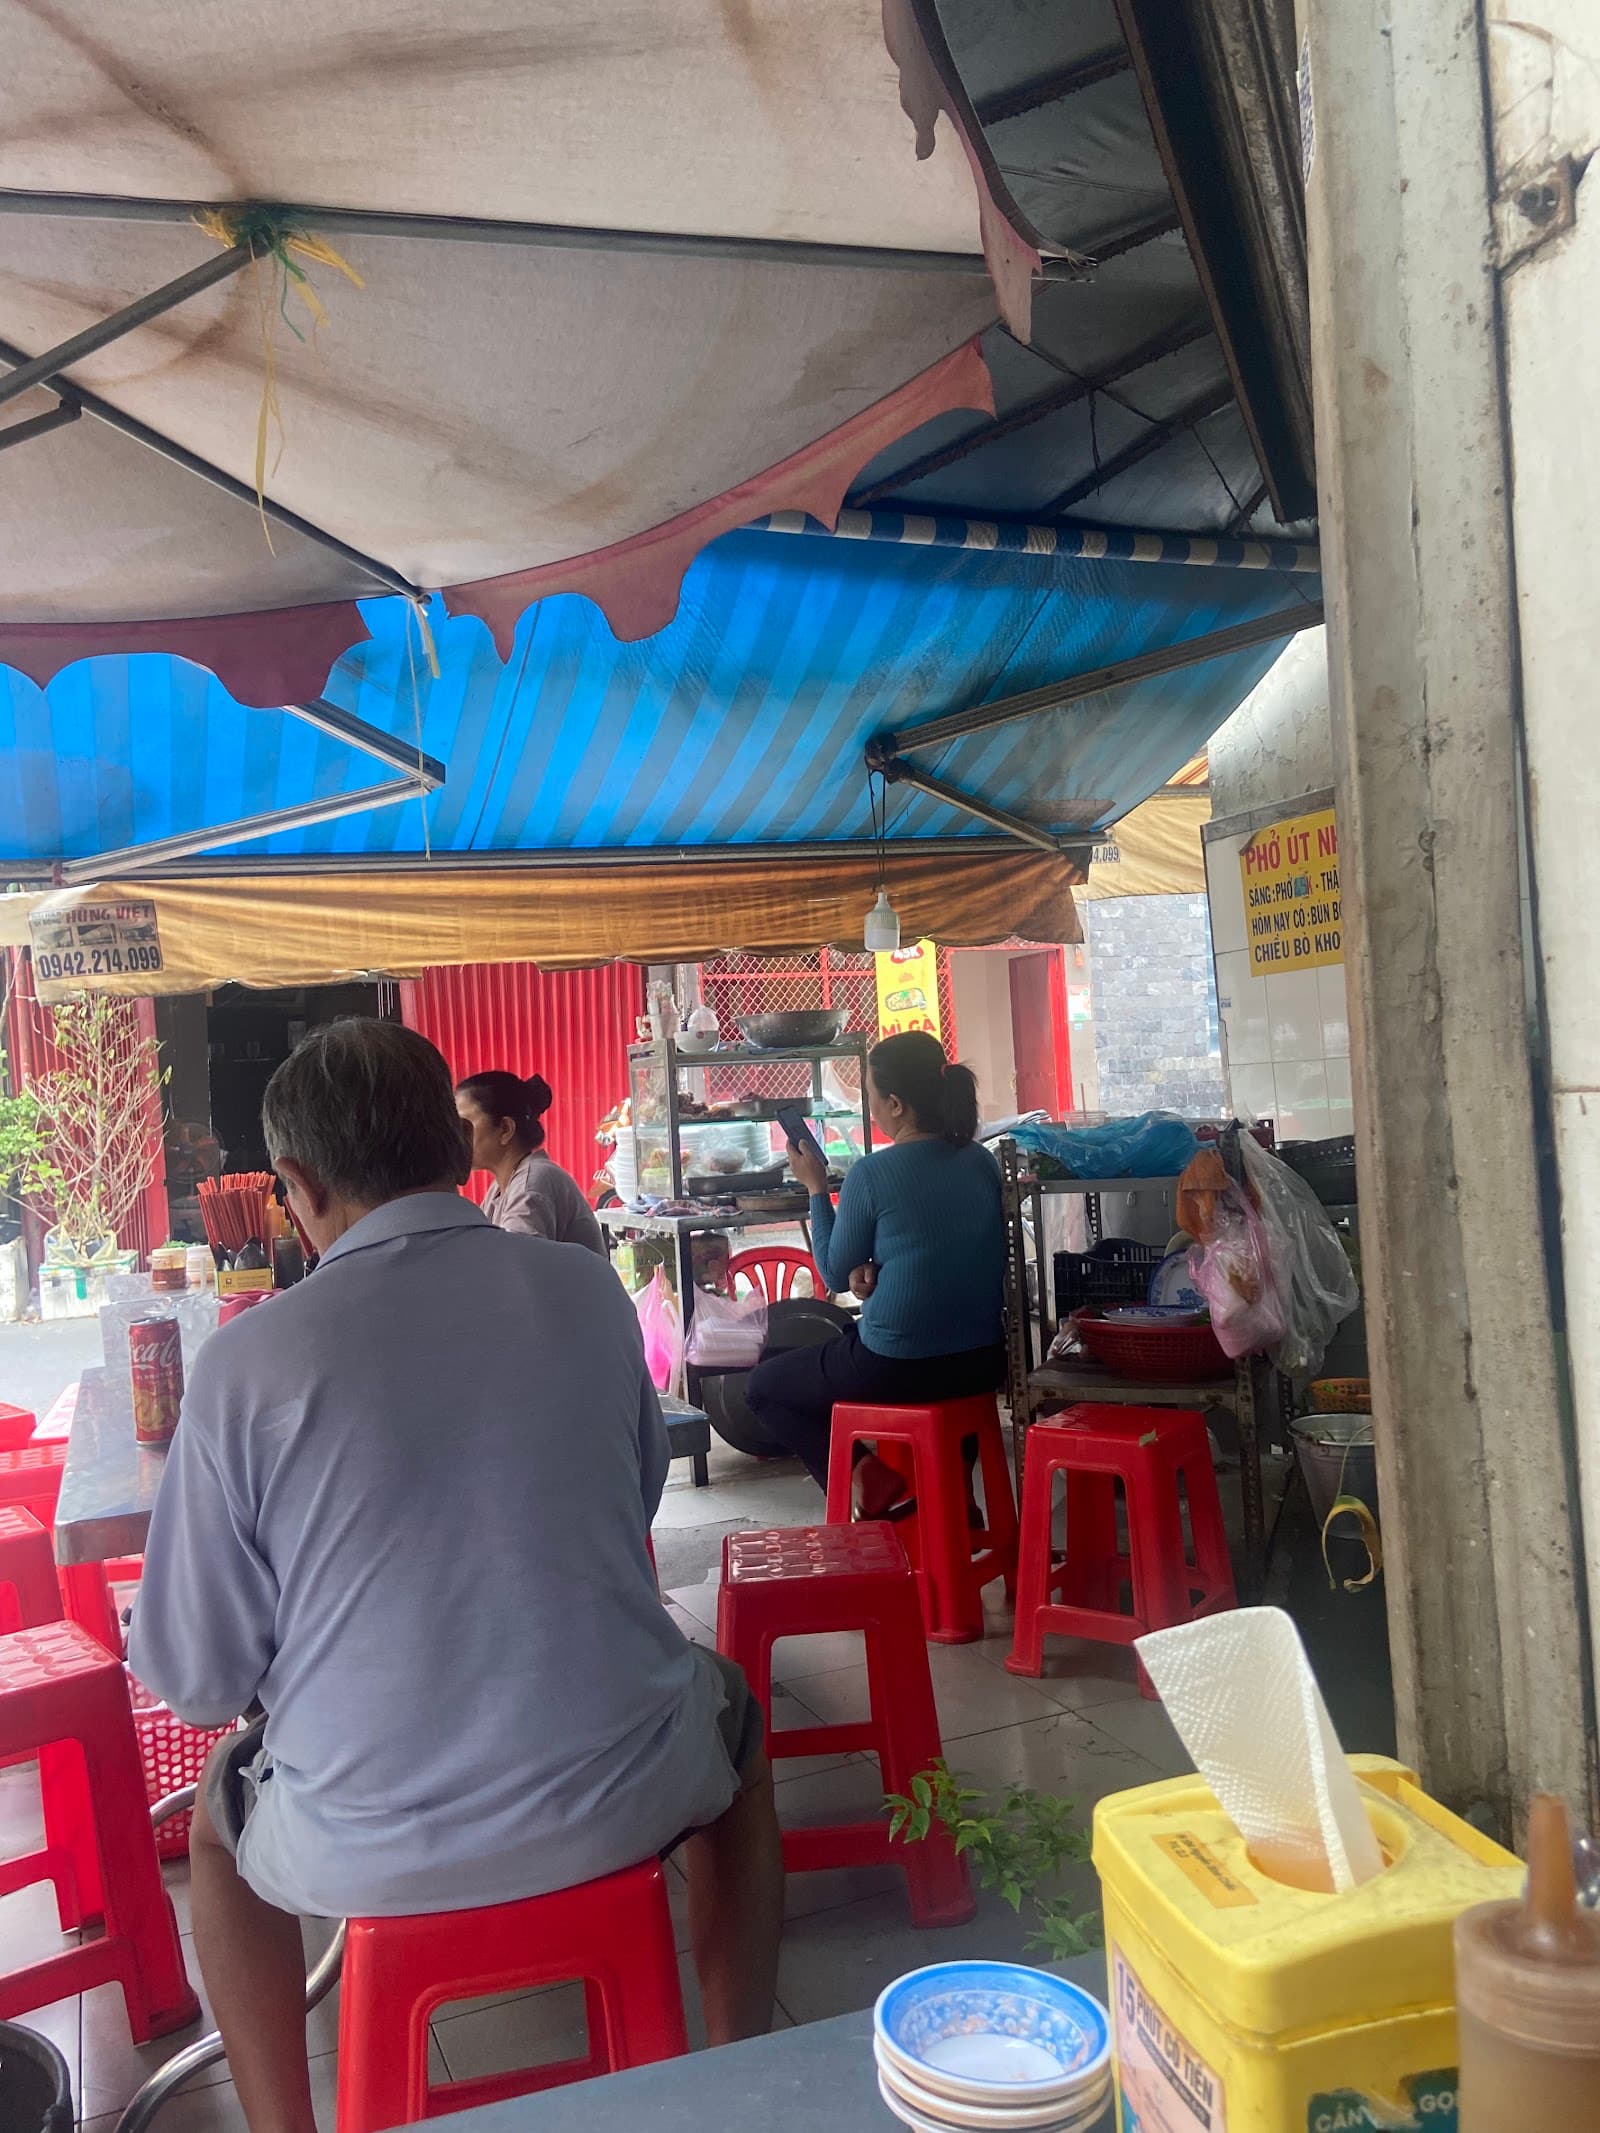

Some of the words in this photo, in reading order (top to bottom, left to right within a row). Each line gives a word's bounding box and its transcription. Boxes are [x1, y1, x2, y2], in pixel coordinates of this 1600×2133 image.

[1245, 829, 1281, 875] PHỞ
[1286, 827, 1310, 864] ÚT
[115, 905, 151, 922] VIỆT
[1274, 911, 1290, 933] NAY
[1254, 933, 1290, 963] CHIỀU
[1294, 931, 1311, 957] BÒ
[1315, 931, 1341, 953] KHO
[38, 945, 161, 979] 0942.214.099
[881, 1018, 902, 1038] MÌ
[1117, 1961, 1135, 2026] 15
[1418, 2091, 1456, 2116] GỌ
